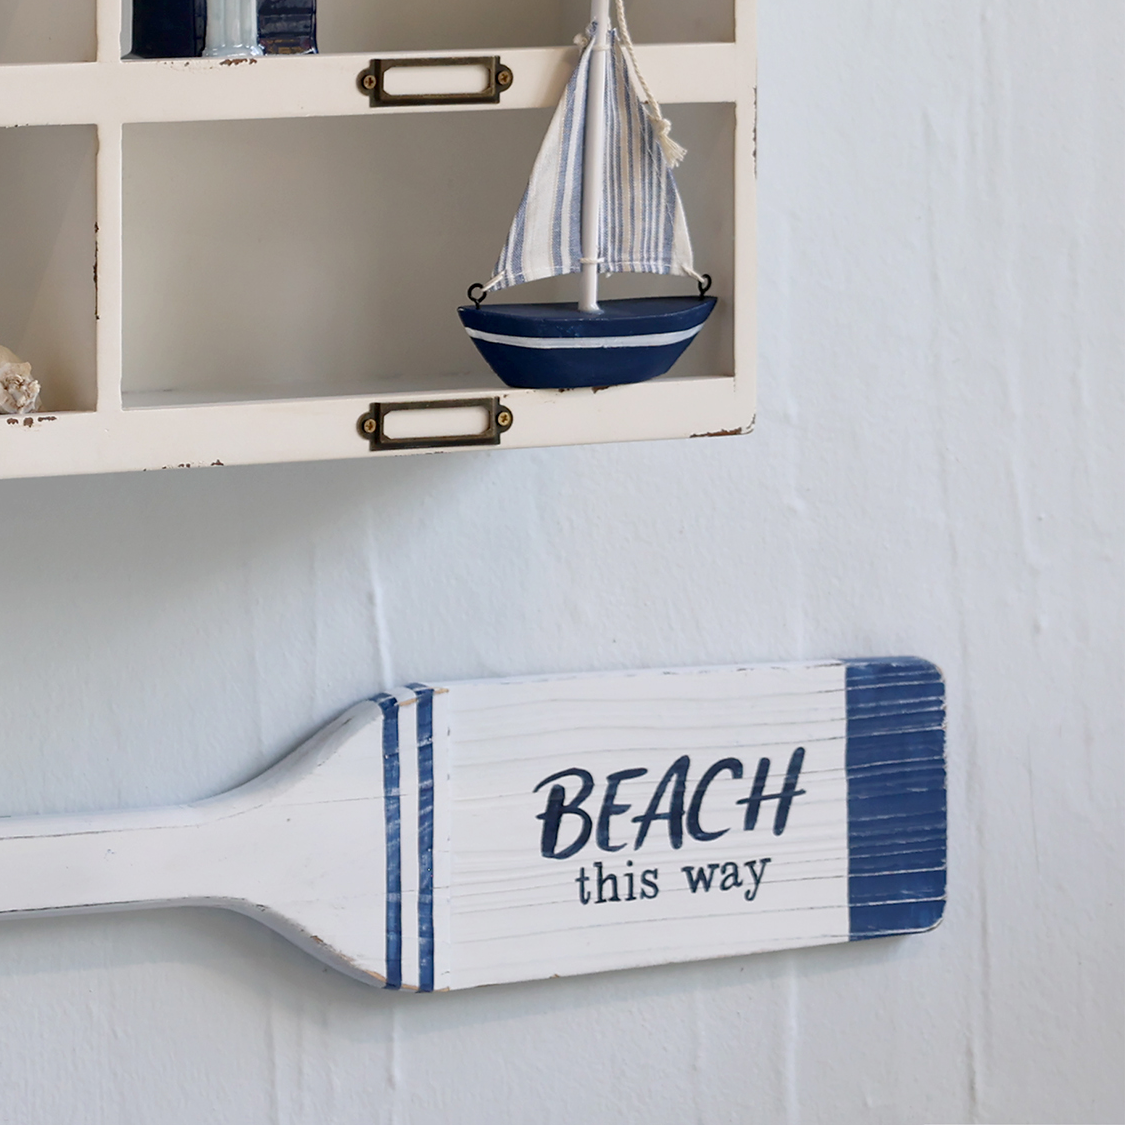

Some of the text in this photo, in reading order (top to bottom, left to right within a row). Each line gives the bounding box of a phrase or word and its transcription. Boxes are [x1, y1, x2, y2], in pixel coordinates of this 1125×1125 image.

[532, 746, 806, 860] BEACH
[574, 857, 772, 905] this way
